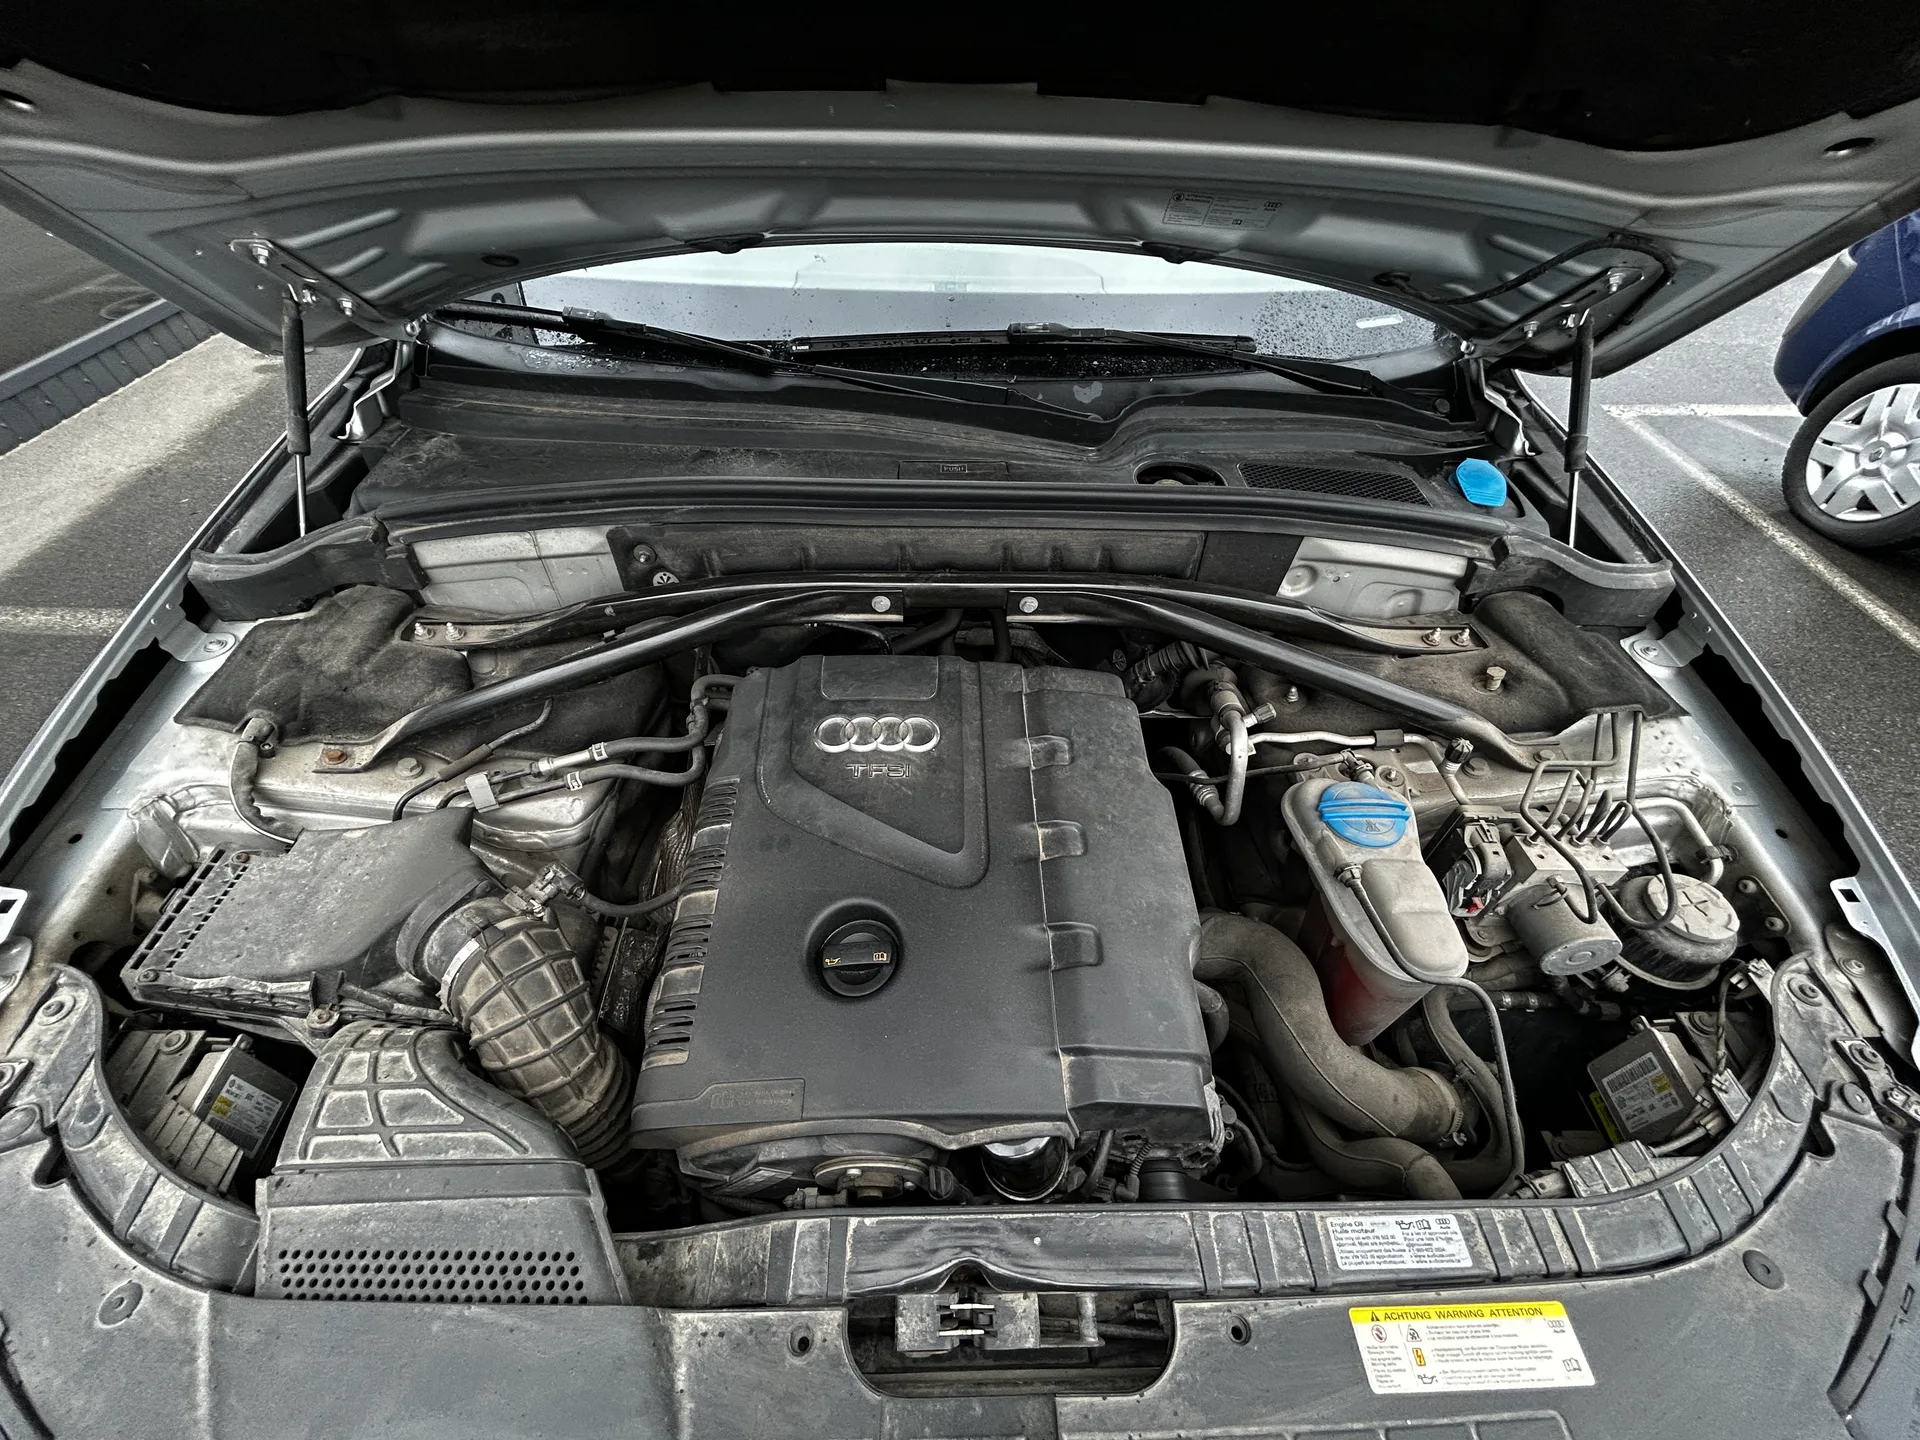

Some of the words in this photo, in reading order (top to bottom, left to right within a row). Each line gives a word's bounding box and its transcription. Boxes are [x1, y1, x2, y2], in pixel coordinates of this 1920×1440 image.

[846, 763, 911, 778] TFSI
[1330, 1221, 1353, 1229] Engine
[1384, 1310, 1432, 1321] ACHTUNG
[1434, 1308, 1485, 1319] WARNING
[1489, 1307, 1544, 1317] ATTENTION
